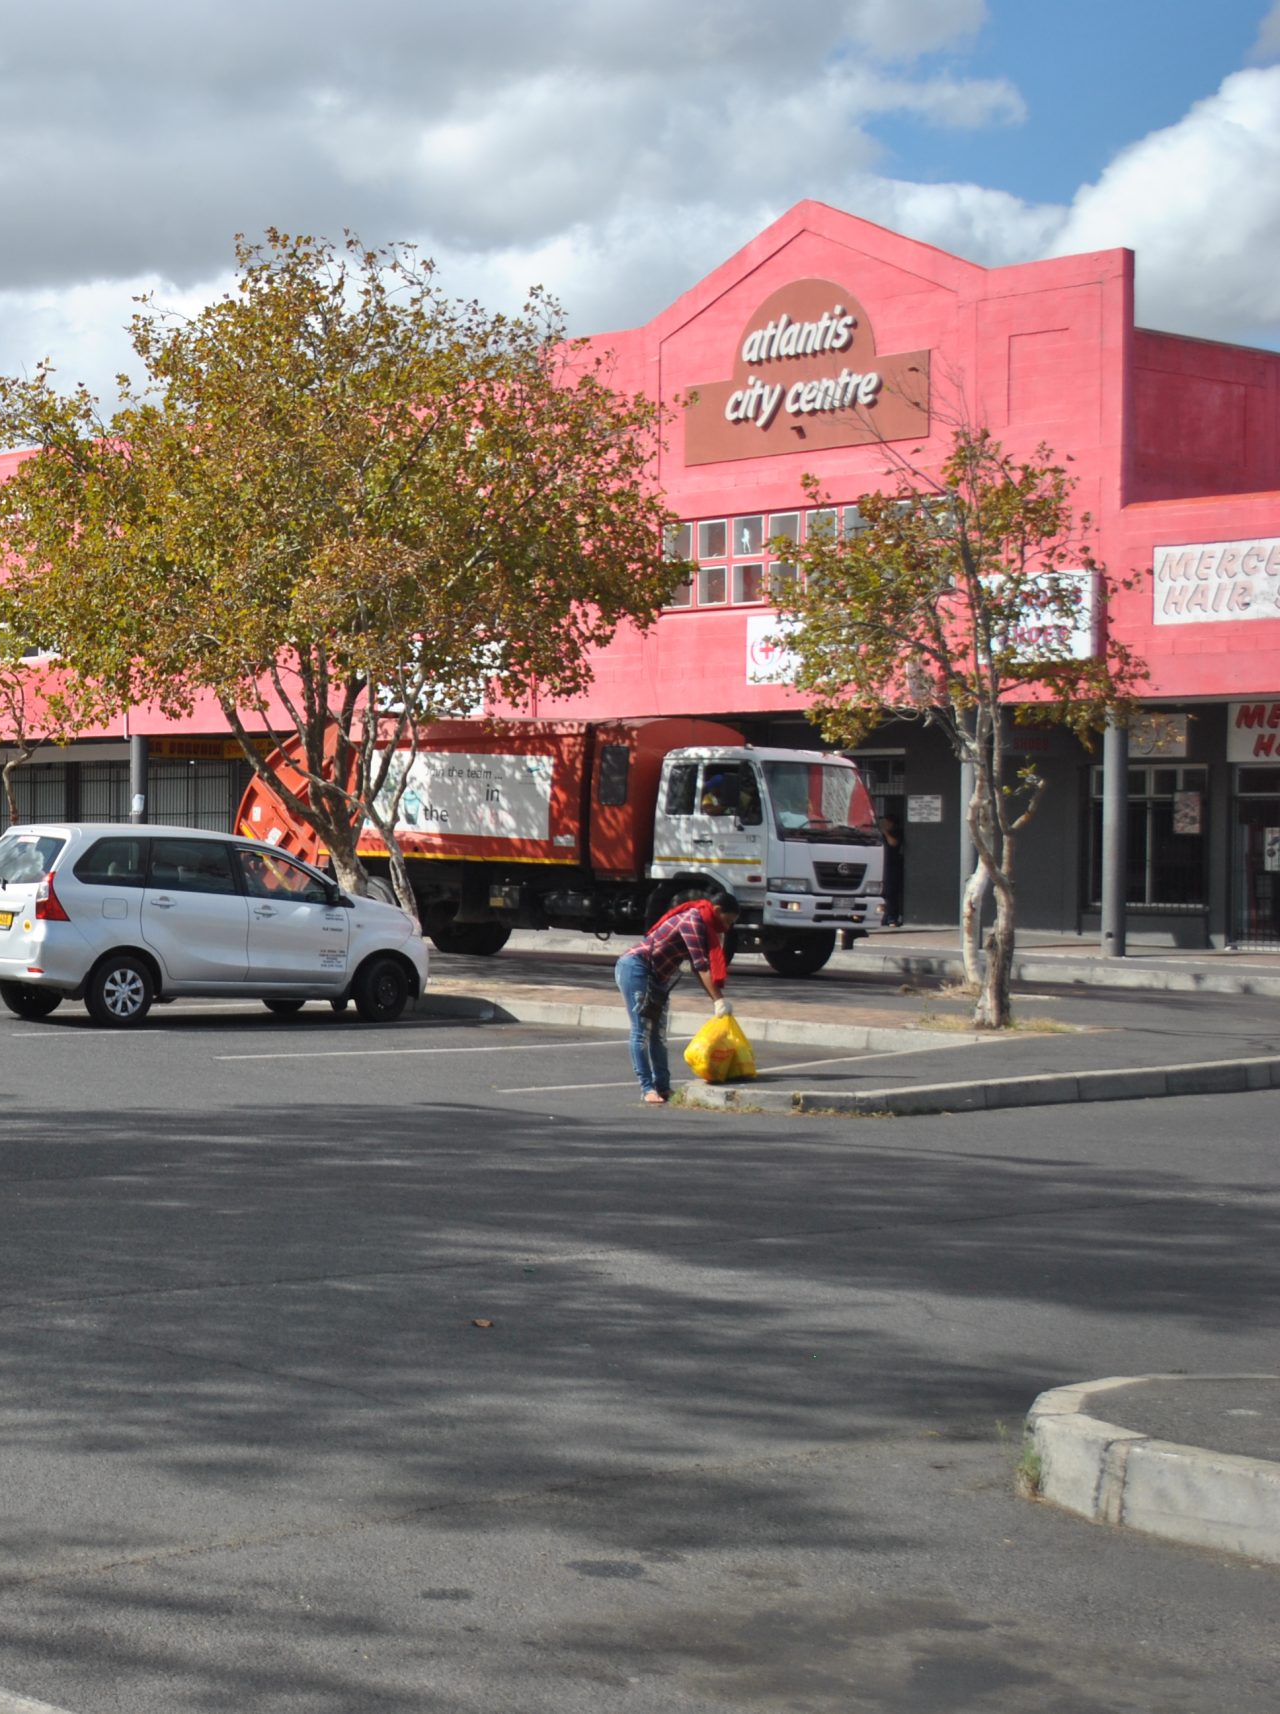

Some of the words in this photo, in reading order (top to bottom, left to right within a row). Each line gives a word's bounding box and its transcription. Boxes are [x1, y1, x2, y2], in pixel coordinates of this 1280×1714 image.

[742, 304, 857, 362] atlantis
[725, 375, 784, 428] city
[785, 368, 881, 414] centre
[1163, 581, 1253, 614] HAIR
[1252, 733, 1280, 757] H
[448, 765, 464, 778] the
[467, 768, 492, 780] team
[486, 783, 500, 802] in
[423, 803, 449, 823] the
